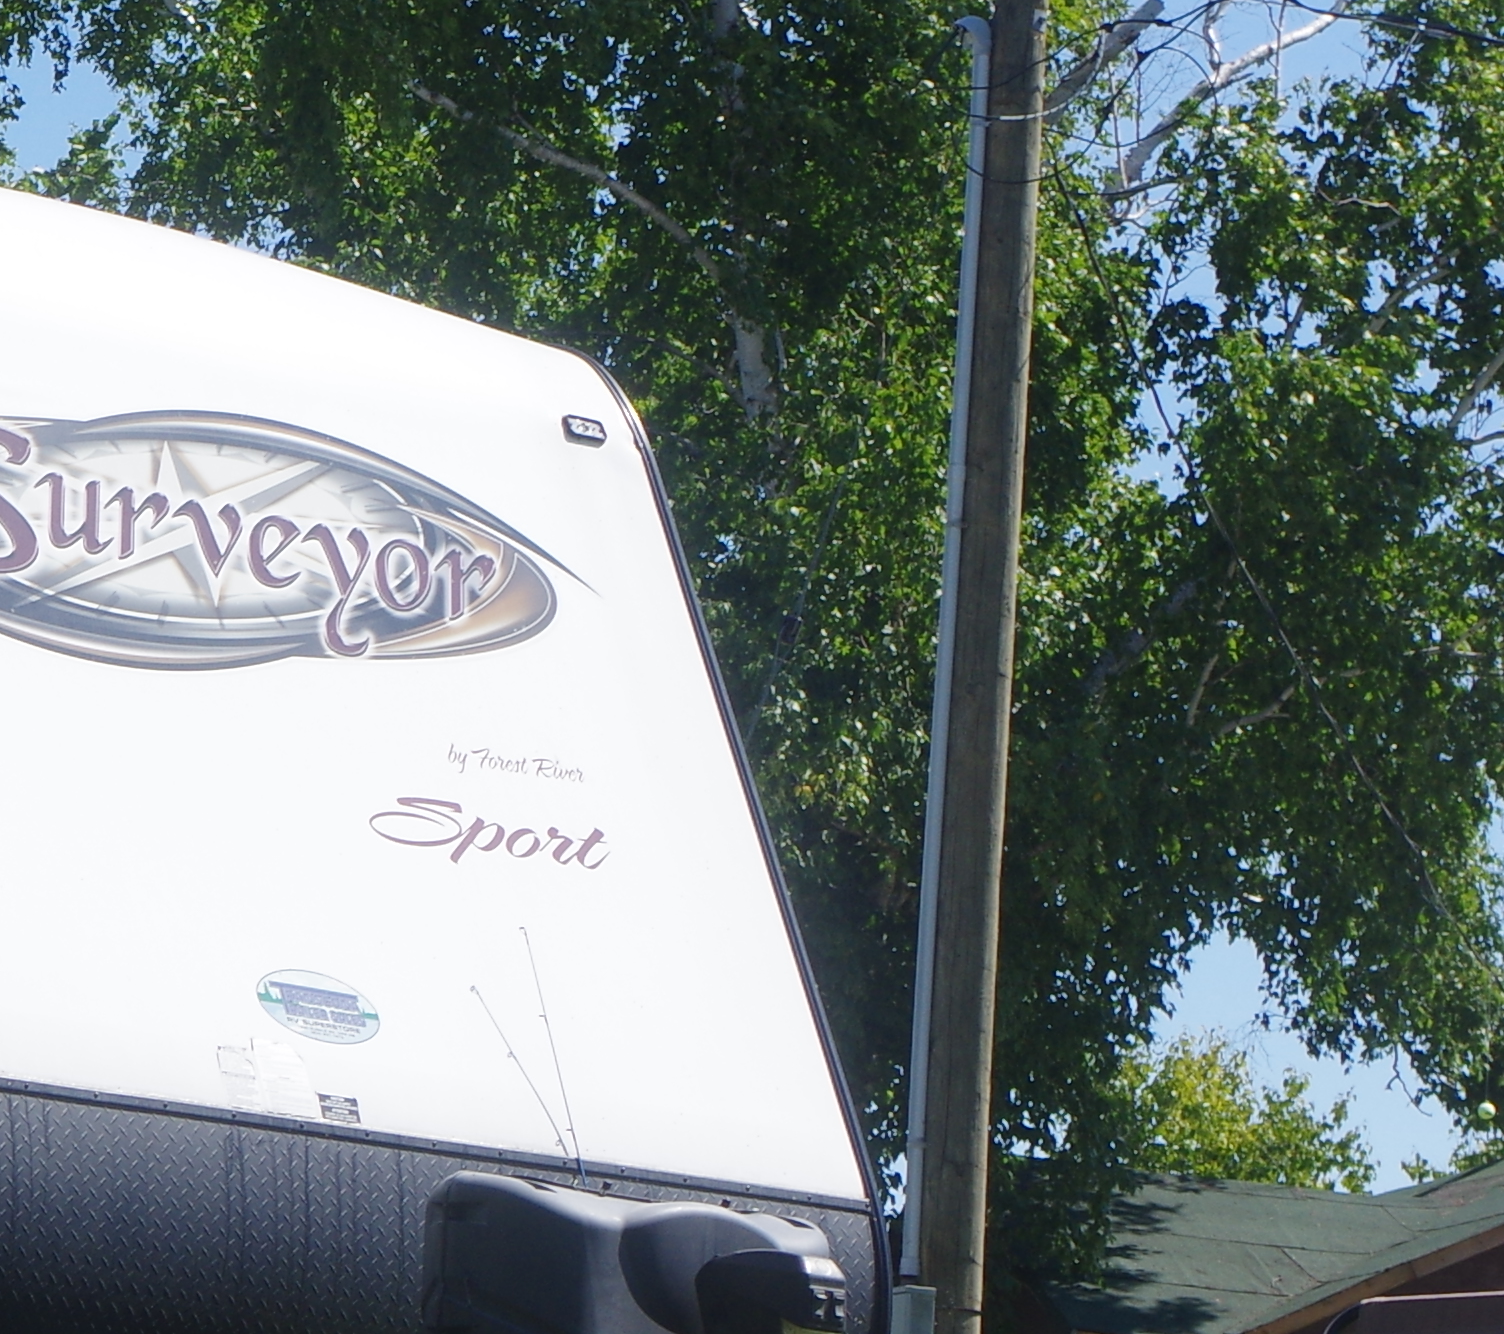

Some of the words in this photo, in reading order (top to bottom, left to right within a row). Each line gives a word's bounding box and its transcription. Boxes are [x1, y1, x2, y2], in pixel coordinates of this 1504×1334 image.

[447, 743, 468, 774] by
[471, 748, 528, 774] Forest
[532, 758, 585, 783] River
[369, 796, 611, 870] Sport
